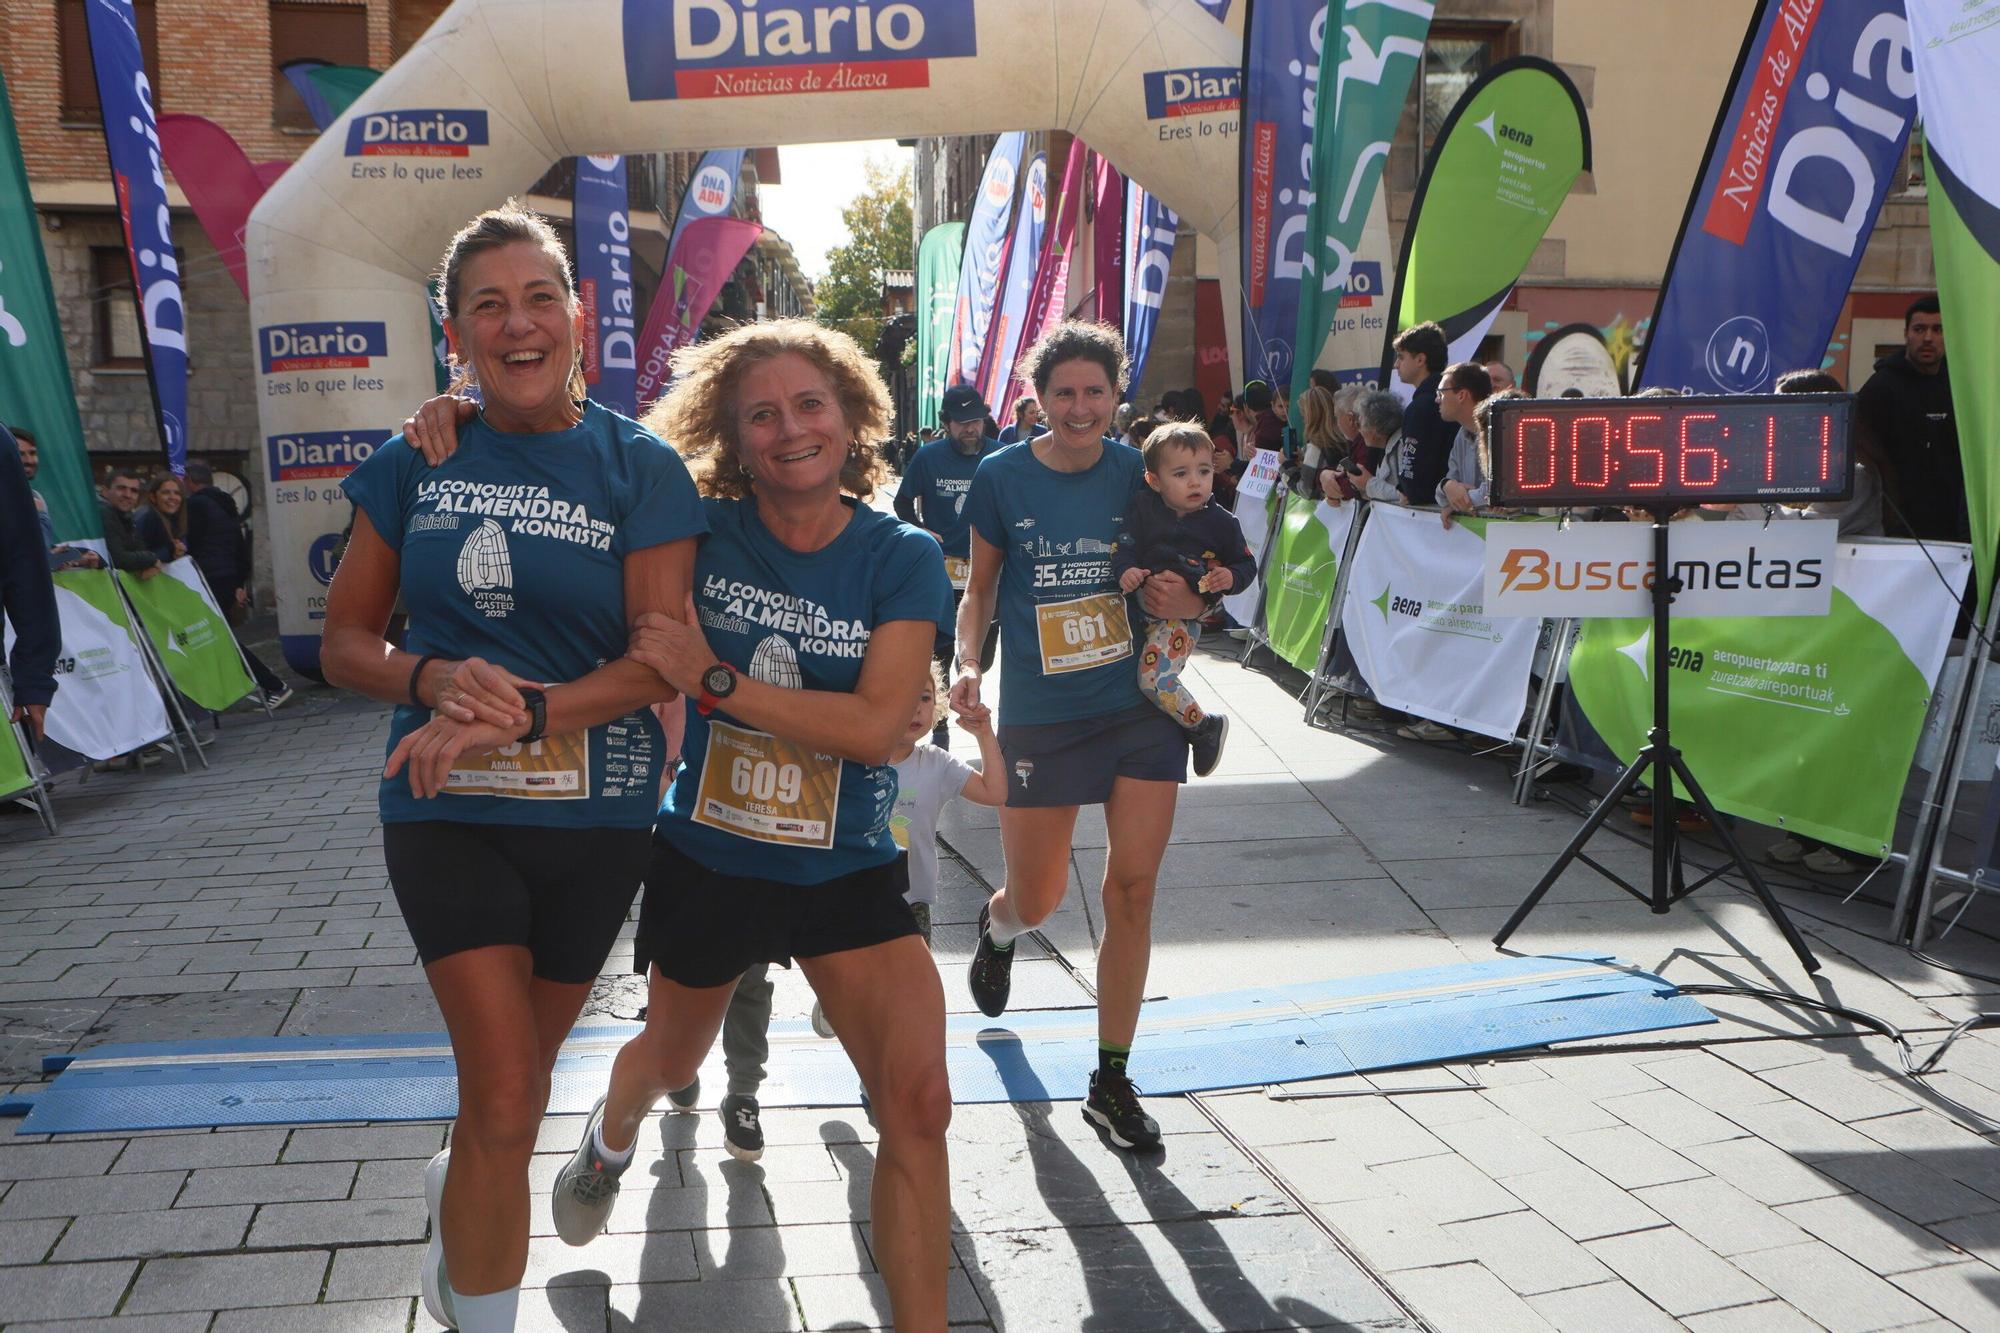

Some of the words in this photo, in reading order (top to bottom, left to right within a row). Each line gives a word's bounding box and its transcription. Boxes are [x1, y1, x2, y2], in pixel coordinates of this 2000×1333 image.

[673, 0, 926, 60] Diario
[713, 71, 794, 96] Noticias
[800, 68, 821, 92] de
[827, 62, 889, 89] Álava
[363, 112, 468, 143] Diario
[1159, 124, 1193, 141] Eres
[1199, 120, 1212, 137] lo
[1499, 123, 1534, 147] aena
[1723, 84, 1779, 212] Noticias
[1772, 48, 1791, 90] de
[351, 162, 387, 179] Eres
[393, 161, 408, 178] lo
[414, 166, 446, 184] que
[452, 163, 483, 180] lees
[701, 174, 725, 190] DNA
[698, 190, 724, 206] ADN
[602, 210, 637, 370] Diario
[1360, 313, 1383, 329] lees
[269, 326, 368, 358] Diario
[267, 379, 292, 396] Eres
[296, 377, 309, 393] lo
[315, 378, 346, 396] que
[353, 374, 384, 391] lees
[277, 434, 375, 467] Diario
[1517, 414, 1831, 489] 00:56:11
[276, 487, 299, 504] Eres
[304, 486, 317, 502] lo
[417, 480, 437, 497] LA
[438, 479, 550, 499] CONQUISTA
[427, 492, 440, 501] LA
[434, 493, 589, 528] ALMENDRA
[589, 518, 616, 536] REN
[511, 517, 612, 552] KONKISTA
[1033, 563, 1058, 588] 35
[473, 591, 515, 602] VITORIA
[703, 587, 717, 598] DE
[705, 573, 727, 592] LA
[728, 581, 829, 620] CONQUISTA
[718, 592, 731, 603] LA
[474, 600, 516, 611] GASTEIZ
[484, 609, 507, 618] 2025
[1391, 595, 1423, 618] aena
[724, 598, 865, 642] ALMENDRA
[1062, 611, 1107, 645] 661
[1815, 663, 1828, 679] ti
[490, 760, 522, 771] AMAIA
[731, 755, 802, 804] 609
[744, 800, 778, 816] TERESA
